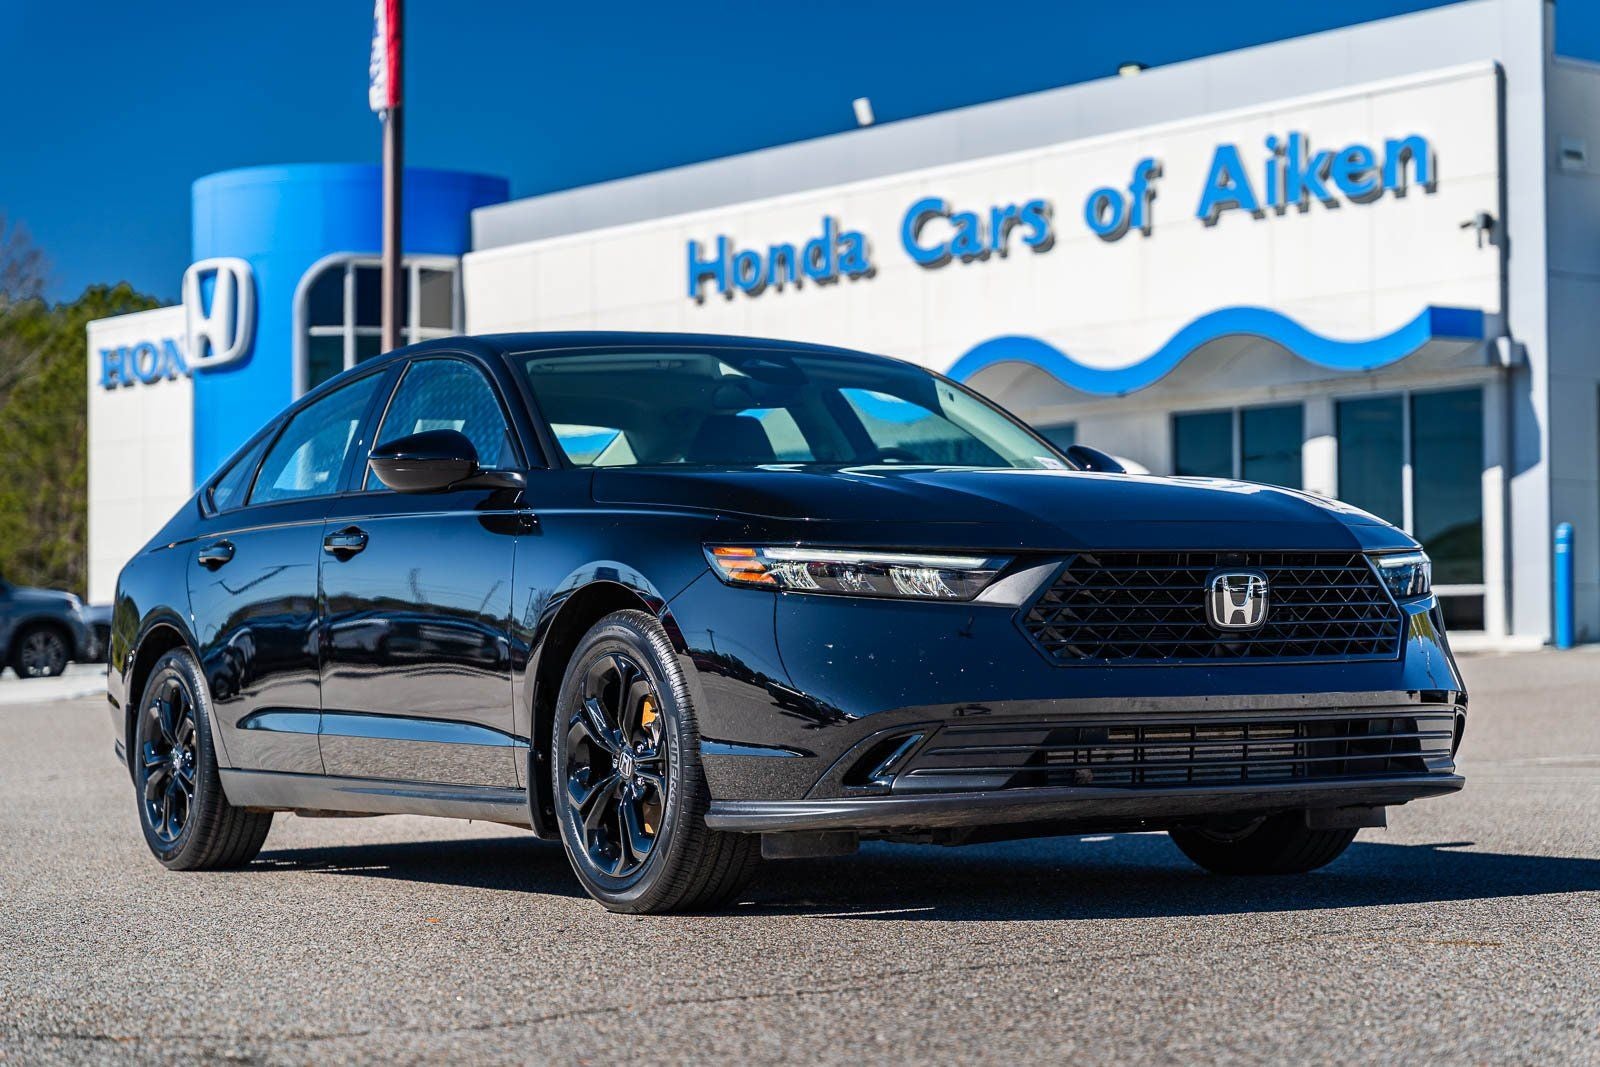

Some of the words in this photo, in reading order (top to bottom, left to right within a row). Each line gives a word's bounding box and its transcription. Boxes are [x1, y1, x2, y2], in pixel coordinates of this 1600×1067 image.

[687, 215, 875, 303] Honda
[900, 197, 1053, 267] Cars
[1085, 157, 1162, 241] of
[1197, 132, 1437, 226] Aiken
